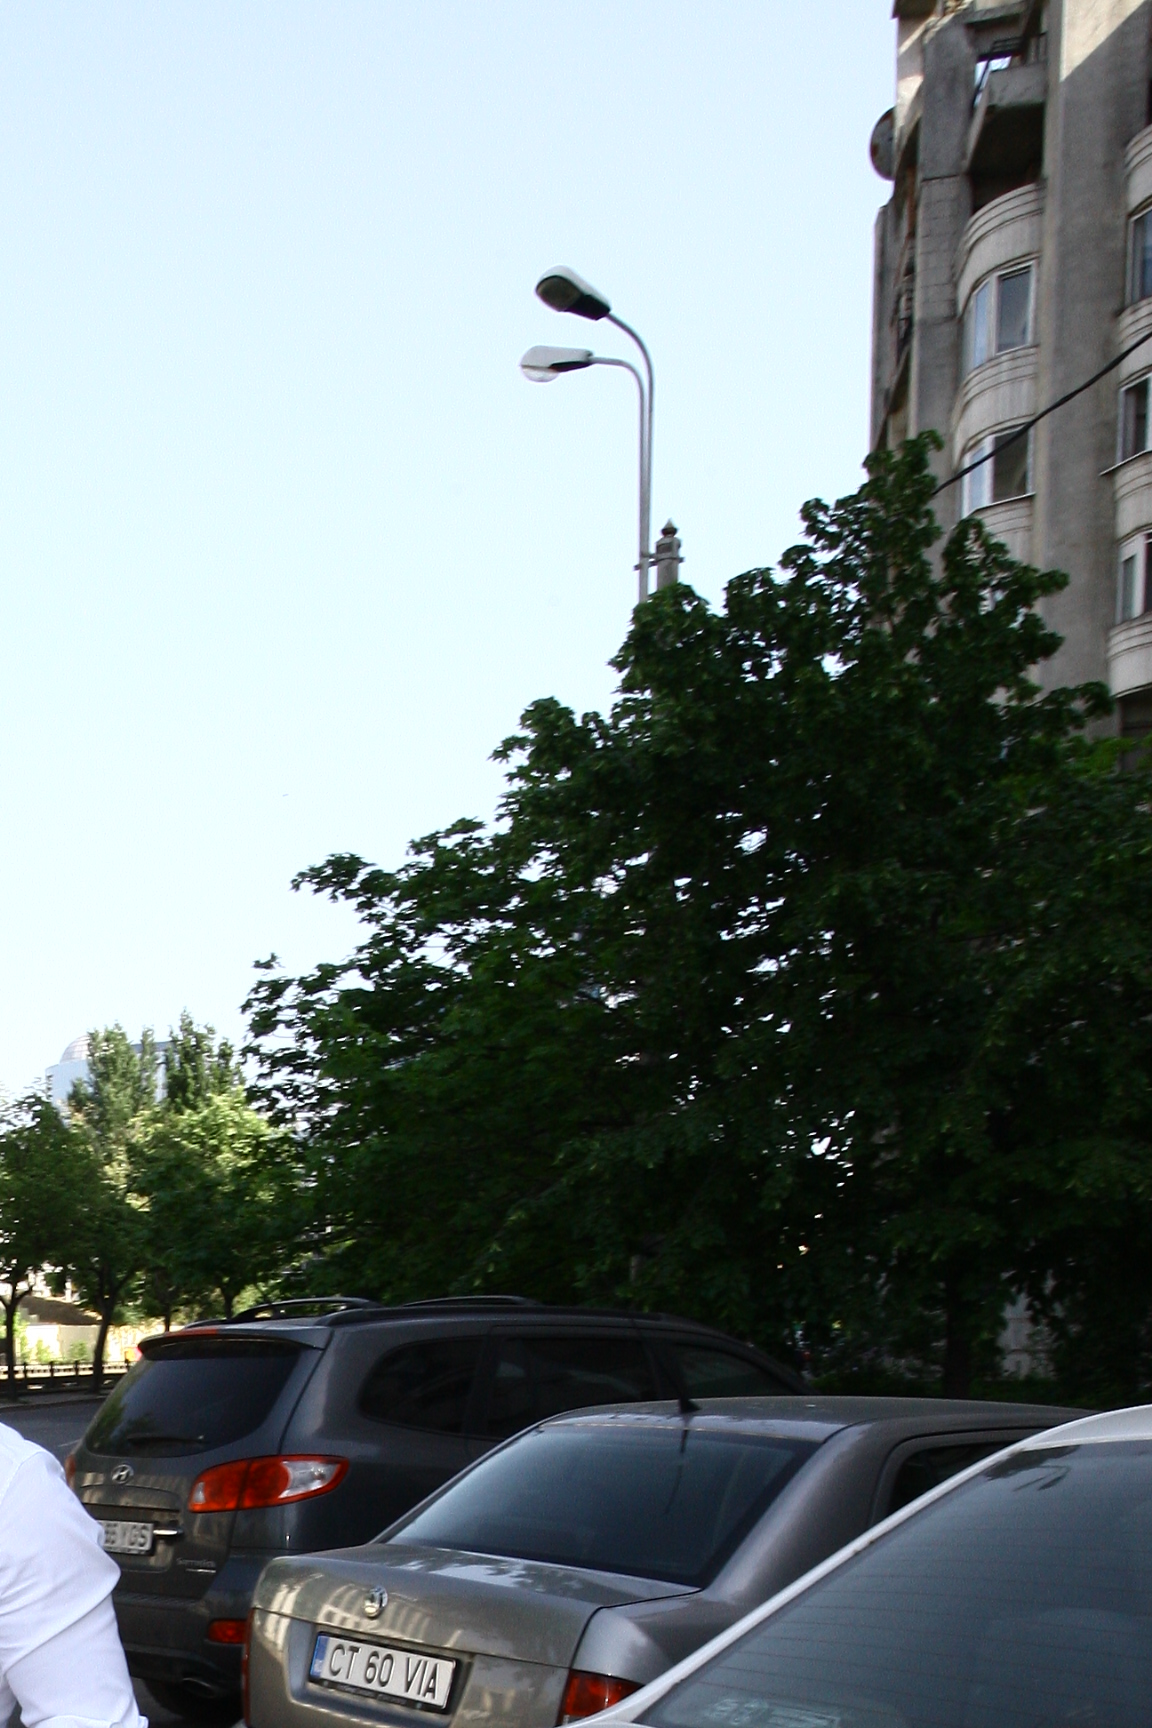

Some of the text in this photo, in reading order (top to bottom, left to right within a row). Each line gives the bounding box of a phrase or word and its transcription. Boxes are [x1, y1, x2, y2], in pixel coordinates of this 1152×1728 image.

[329, 1643, 361, 1679] CT
[364, 1650, 394, 1688] 60
[405, 1657, 440, 1700] VIA
